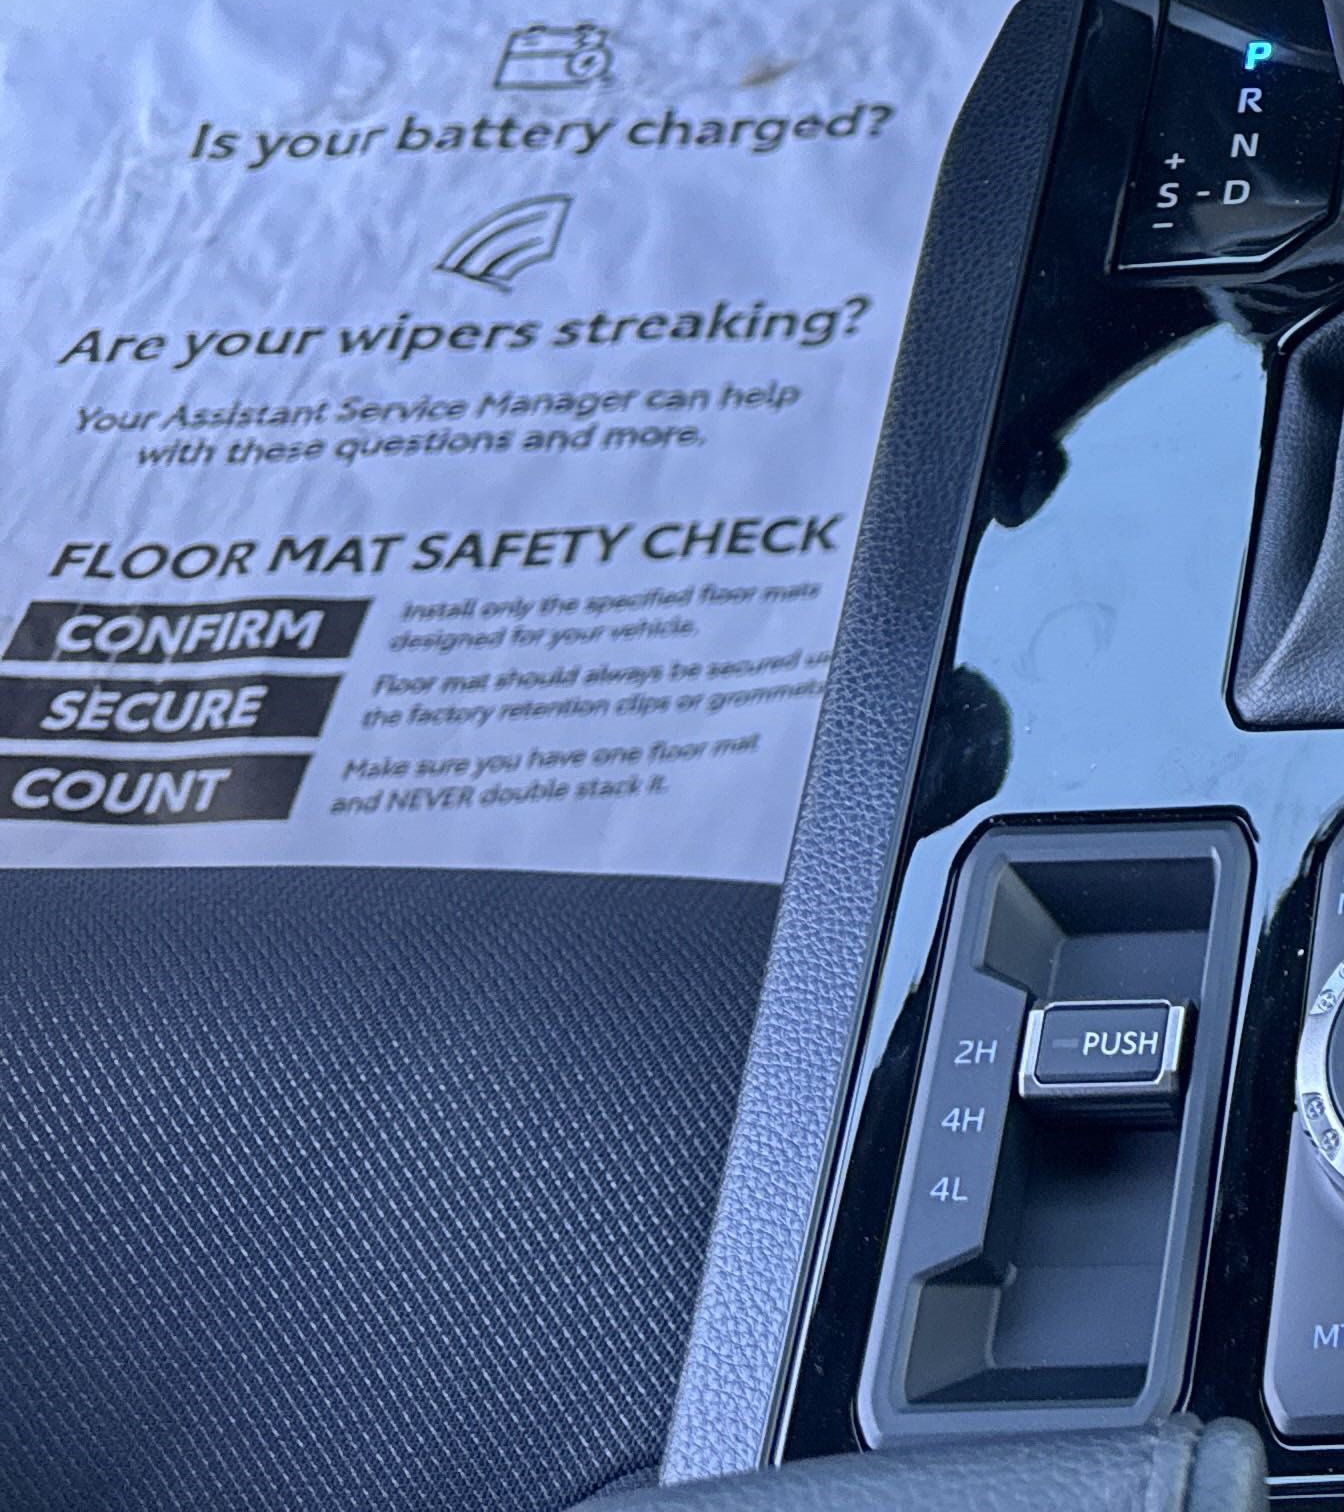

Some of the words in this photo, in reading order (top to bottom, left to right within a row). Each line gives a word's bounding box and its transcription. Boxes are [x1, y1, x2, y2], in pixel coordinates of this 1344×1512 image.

[1244, 40, 1272, 70] P
[1237, 87, 1263, 113] R
[190, 122, 235, 161] Is
[247, 124, 383, 171] your
[397, 114, 613, 155] battery
[627, 103, 896, 154] charged?
[1231, 132, 1259, 158] N
[1156, 182, 1180, 208] S
[1222, 180, 1251, 206] D
[58, 327, 167, 367] Are
[175, 325, 317, 370] your
[339, 314, 540, 360] wipers
[552, 294, 872, 350] streaking?
[74, 403, 157, 435] Your
[166, 398, 328, 430] Assistant
[335, 394, 466, 425] Service
[478, 387, 638, 423] Manager
[645, 385, 710, 412] can
[718, 378, 801, 416] help
[137, 438, 214, 468] with
[225, 435, 325, 466] these
[335, 429, 512, 465] questions
[522, 423, 593, 450] and
[603, 423, 706, 449] more.
[50, 539, 260, 583] FLOOR
[267, 532, 403, 576] MAT
[411, 523, 634, 573] SAFETY
[642, 512, 846, 559] CHECK
[55, 608, 323, 657] CONFIRM
[41, 687, 266, 734] SECURE
[10, 767, 231, 815] COUNT
[953, 1040, 998, 1064] 2H
[1081, 1031, 1160, 1056] PUSH
[940, 1108, 985, 1133] 4H
[929, 1177, 969, 1202] 4L
